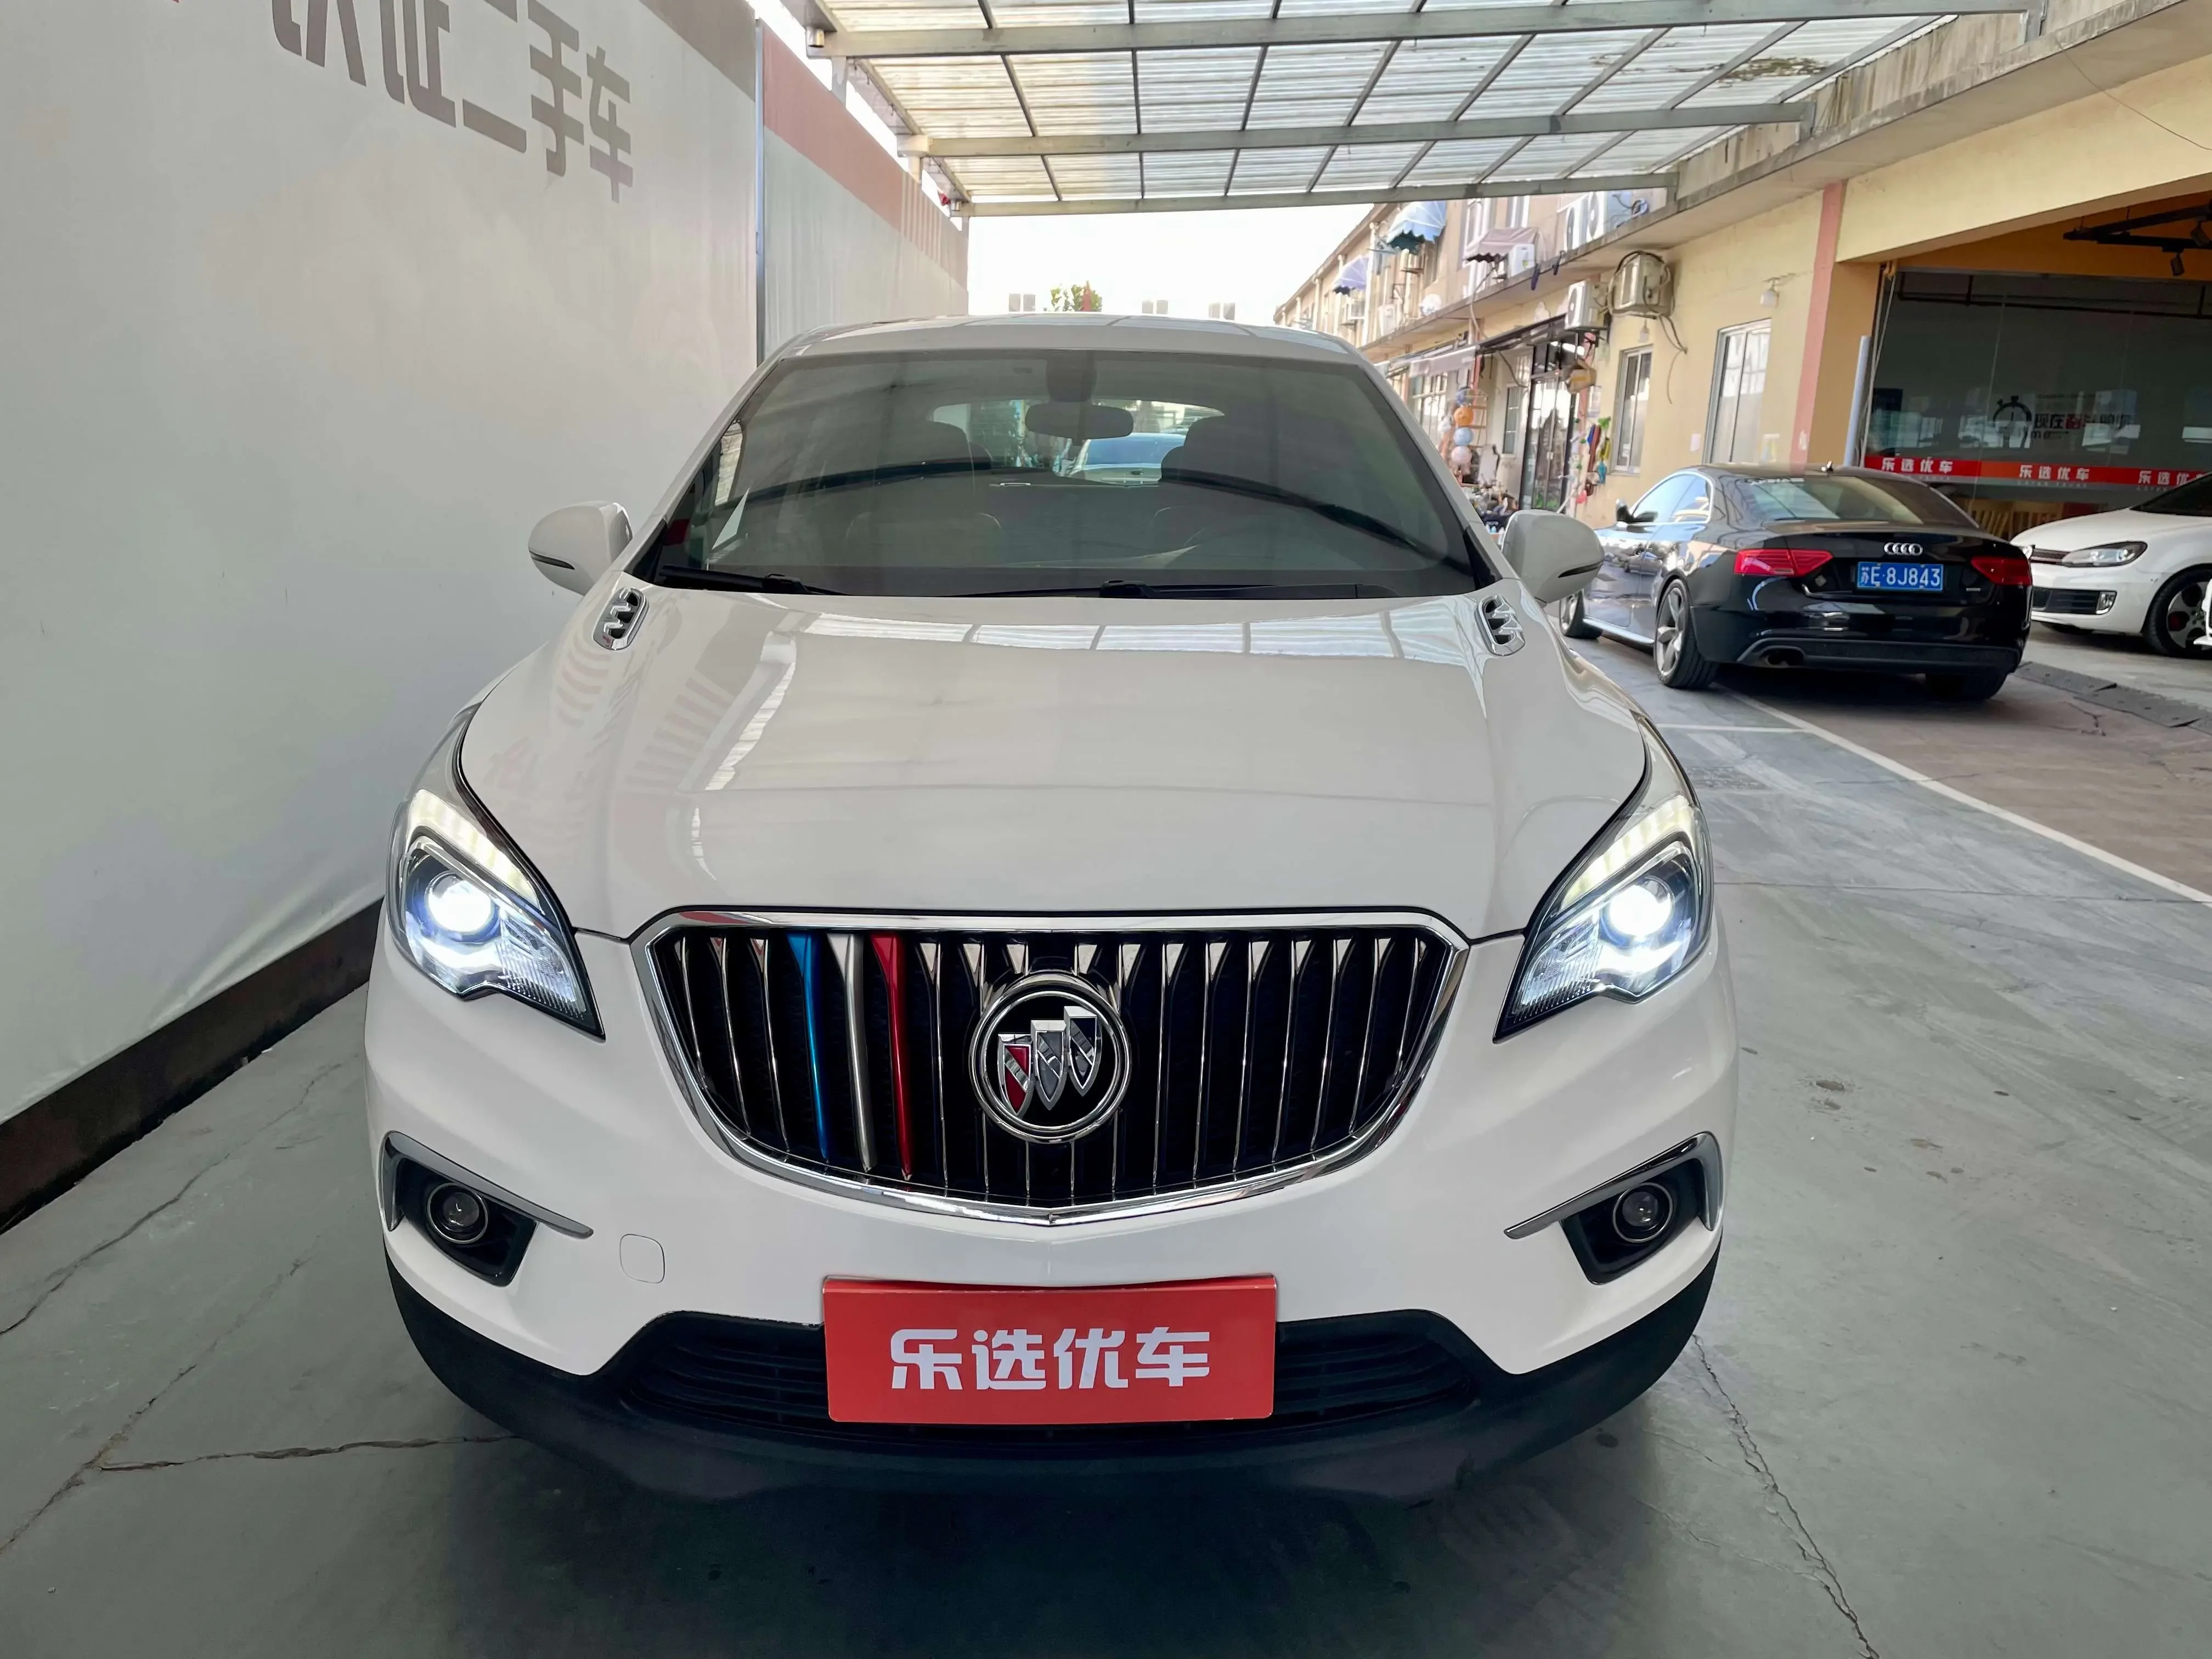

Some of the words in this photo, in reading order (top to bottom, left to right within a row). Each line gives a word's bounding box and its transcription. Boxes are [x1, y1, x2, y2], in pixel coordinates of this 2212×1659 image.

[1882, 457, 1954, 473] 乐选优车
[2019, 465, 2090, 481] 乐选优车
[2138, 470, 2204, 486] 乐选优
[890, 1327, 1210, 1390] 乐选优车
